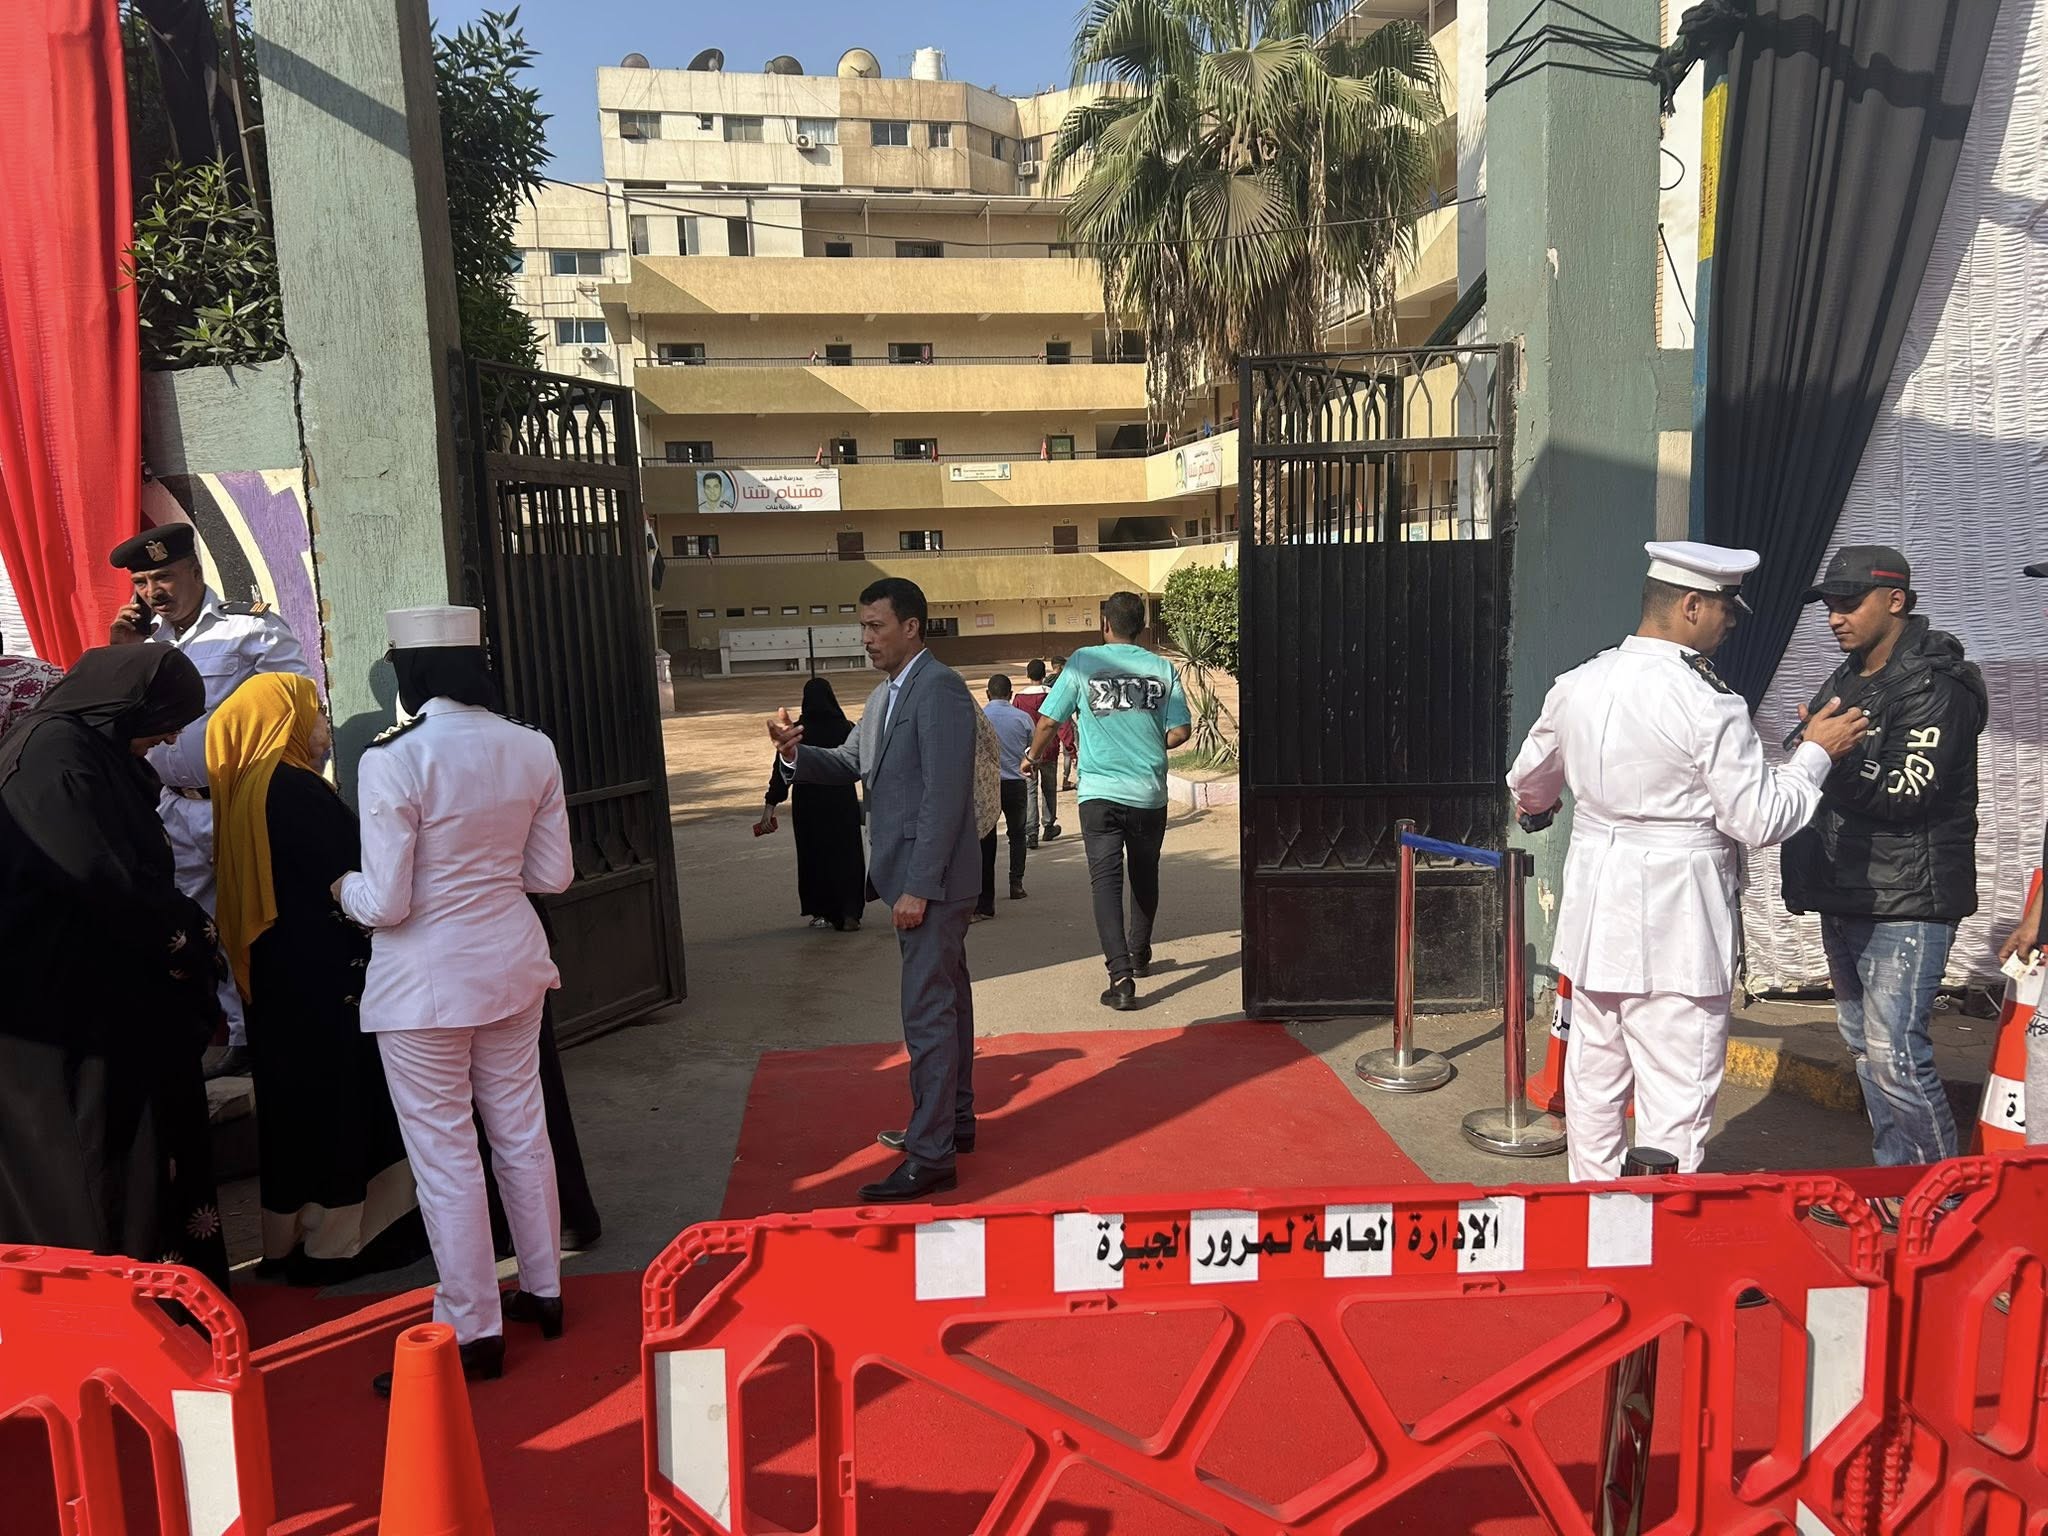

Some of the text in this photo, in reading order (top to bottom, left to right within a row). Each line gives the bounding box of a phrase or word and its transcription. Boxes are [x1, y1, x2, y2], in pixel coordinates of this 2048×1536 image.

[774, 484, 823, 503] هشام
[1096, 1212, 1499, 1272] الإدارة العامة لمرور الجيزة
